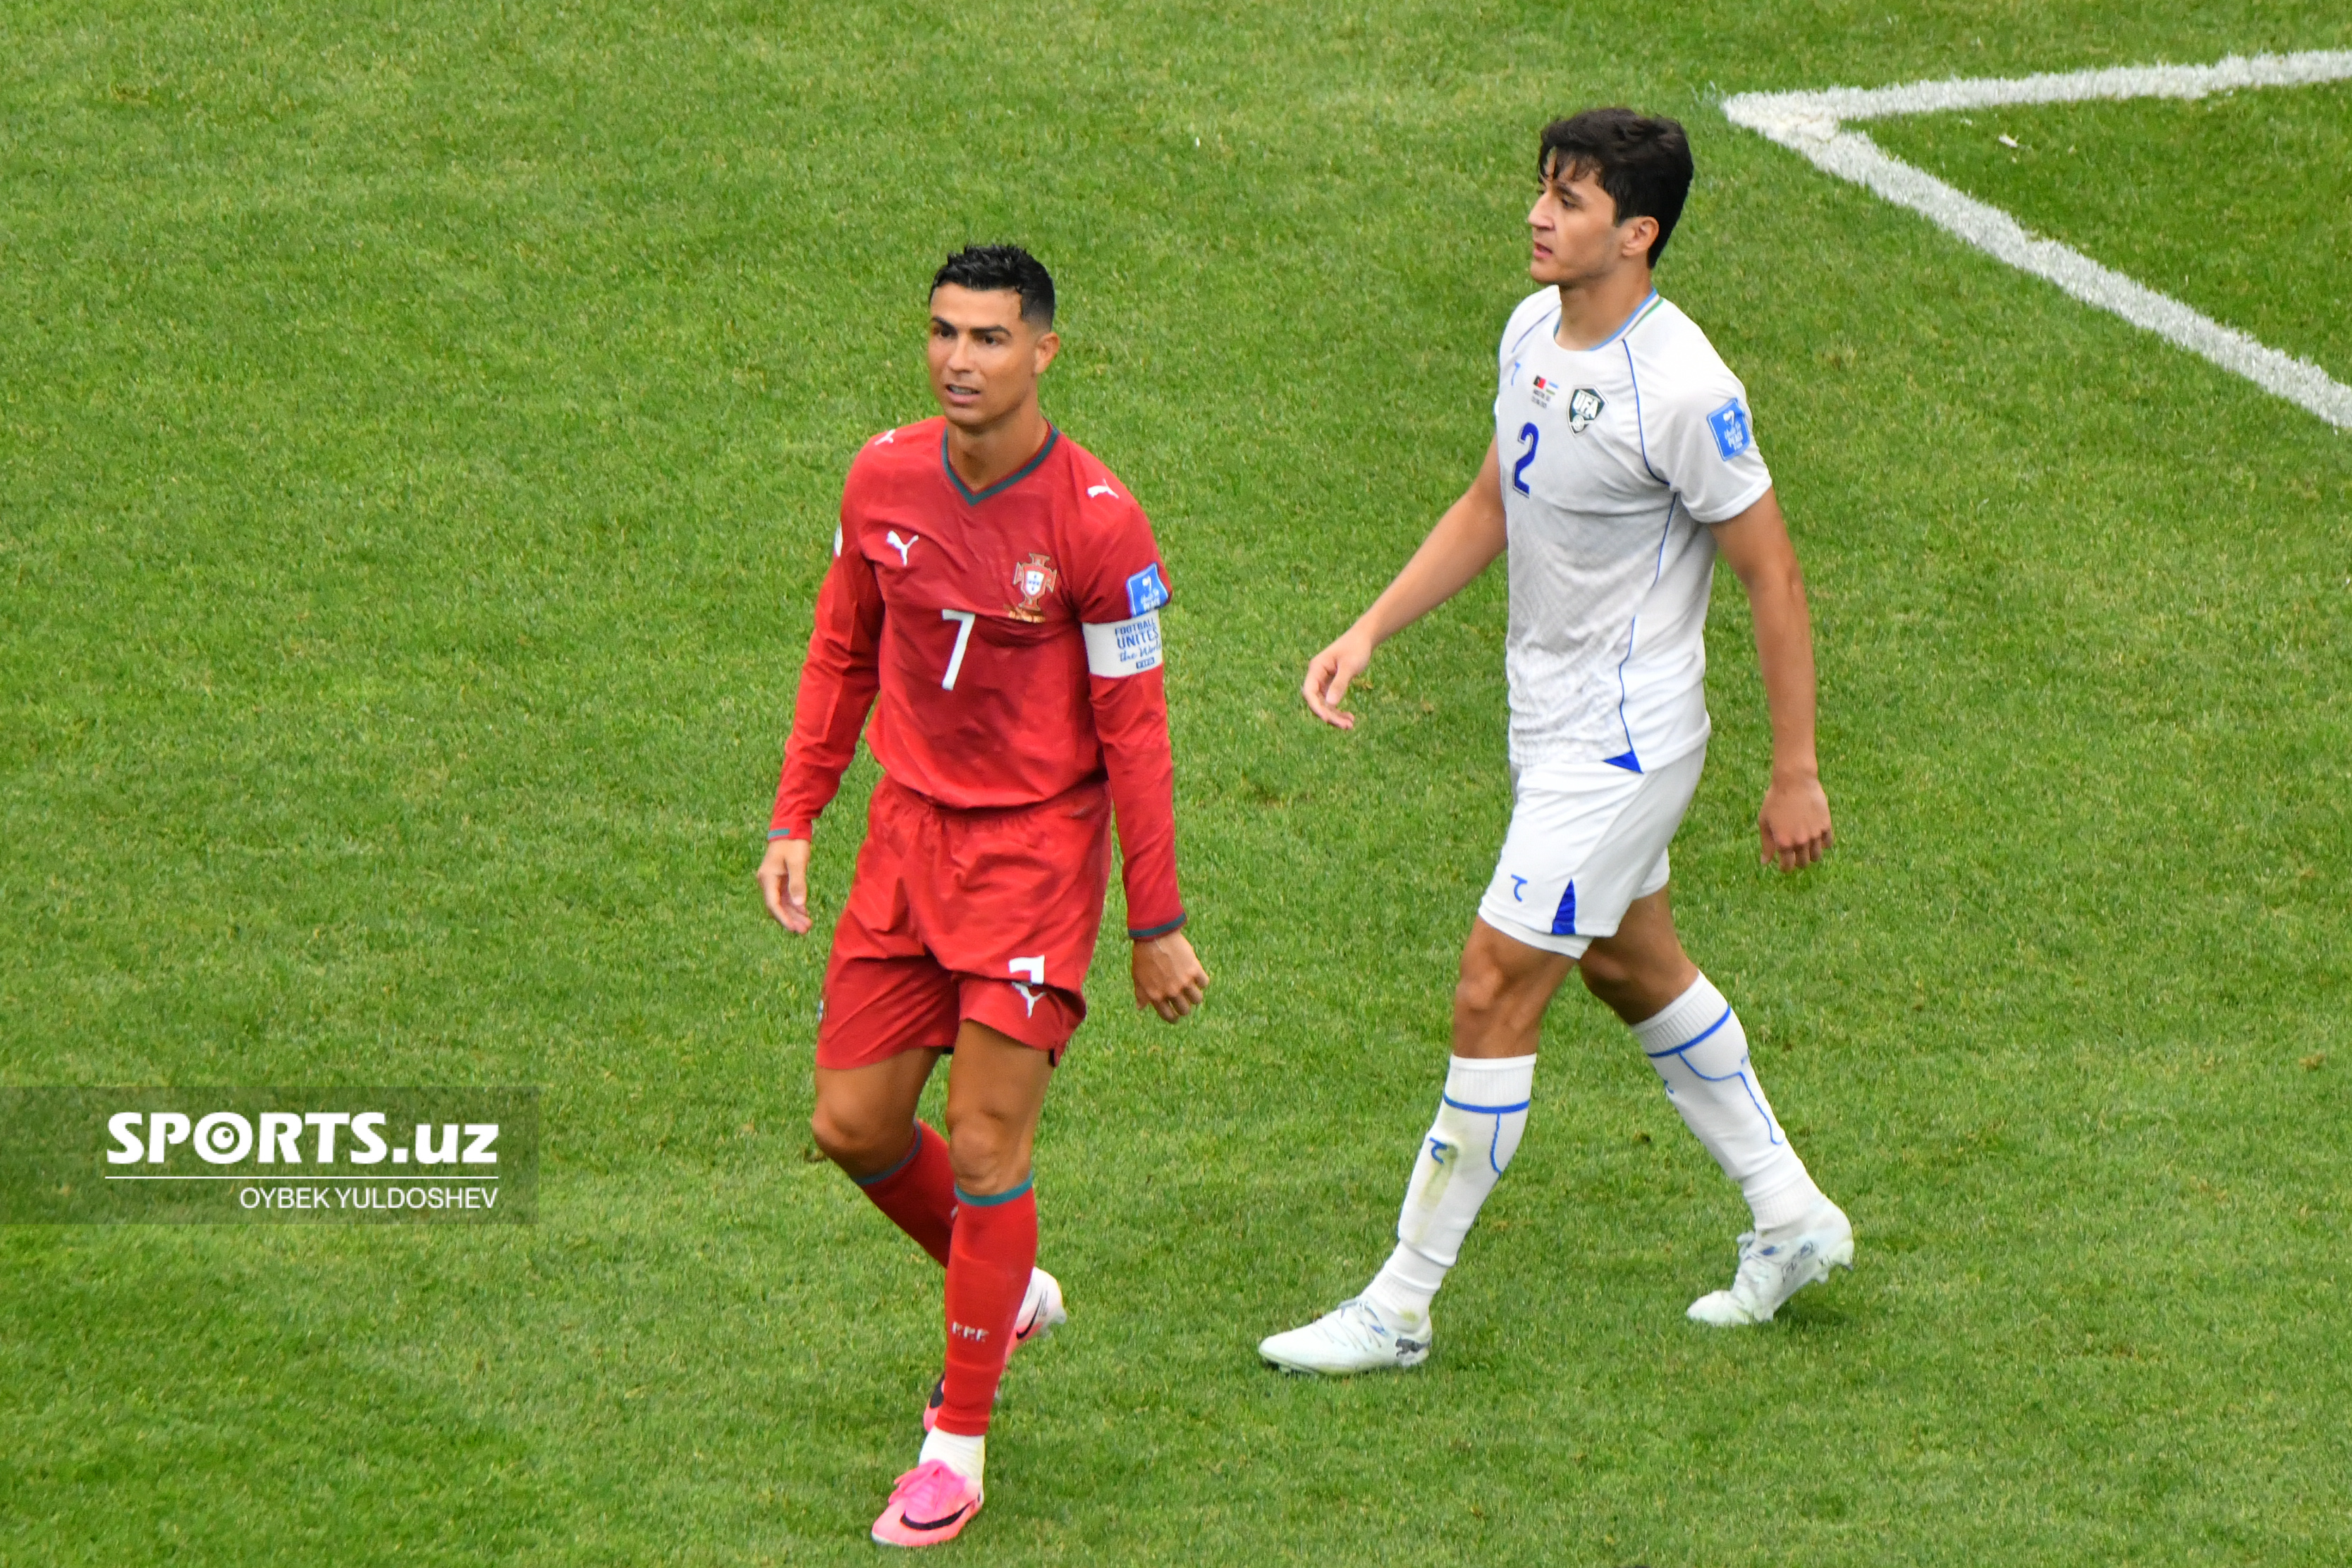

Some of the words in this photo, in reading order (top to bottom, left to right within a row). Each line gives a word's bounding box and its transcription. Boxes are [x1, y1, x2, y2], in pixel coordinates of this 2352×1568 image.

[1513, 422, 1540, 498] 2
[1115, 618, 1156, 636] FOOTBALL
[1117, 624, 1159, 649] UNITES
[942, 608, 976, 691] 7
[1120, 649, 1137, 662] the
[1008, 955, 1046, 985] 7
